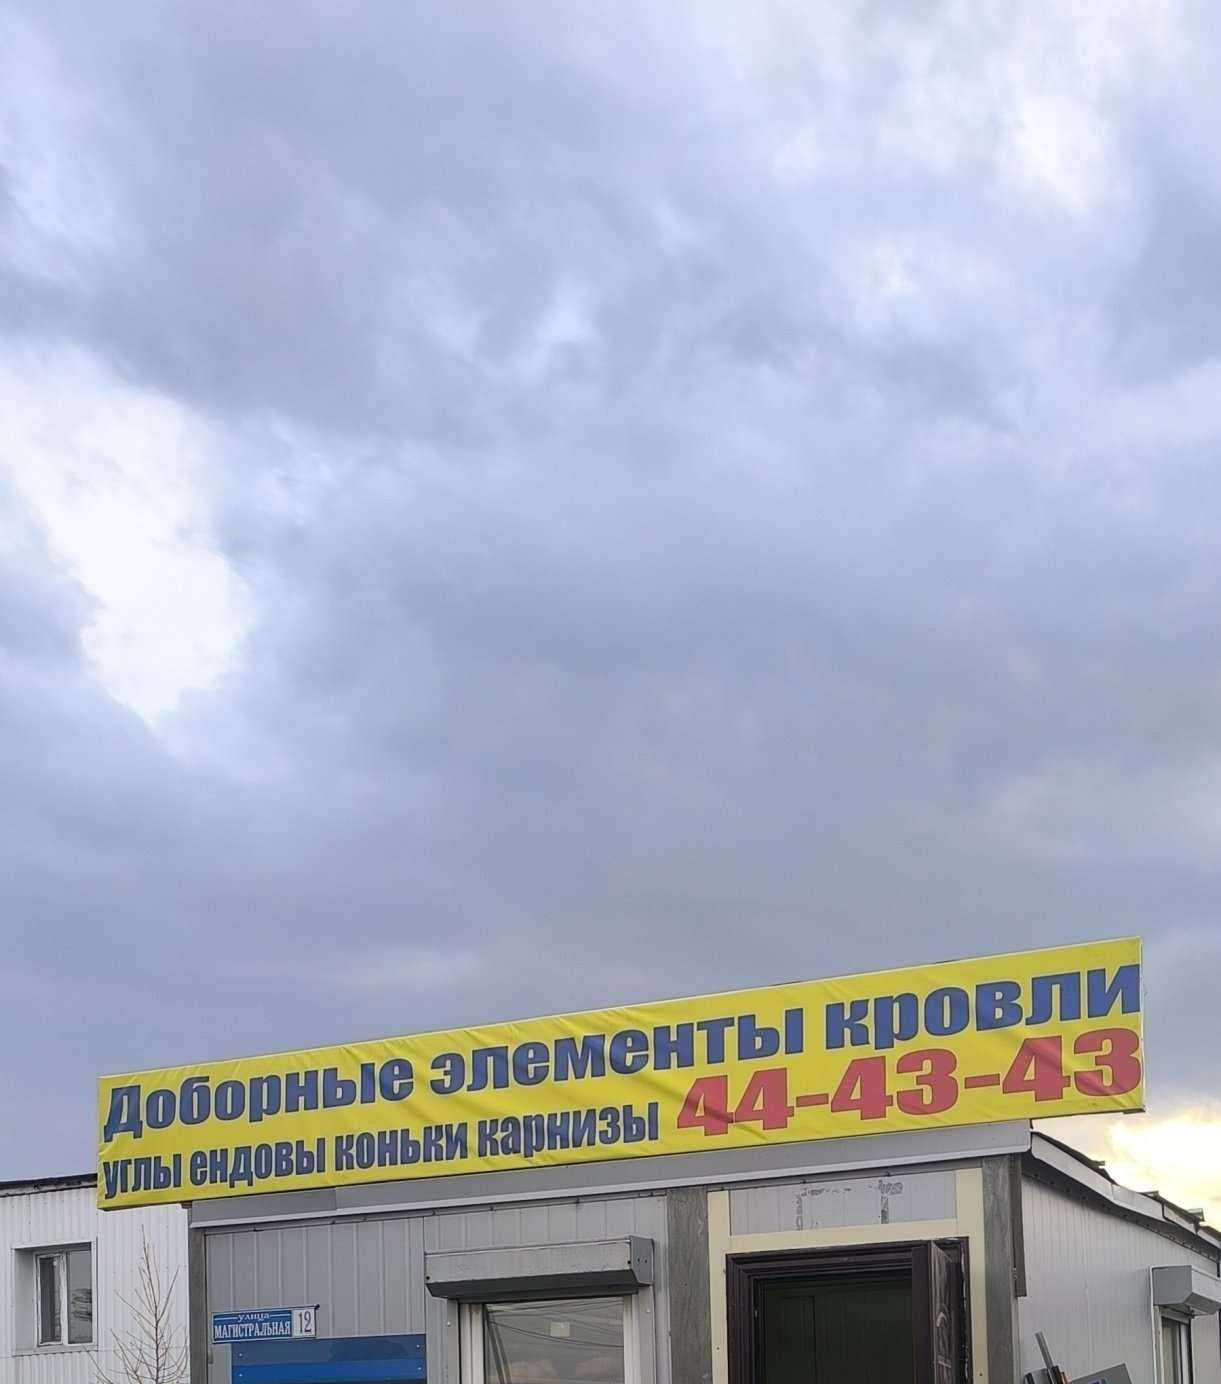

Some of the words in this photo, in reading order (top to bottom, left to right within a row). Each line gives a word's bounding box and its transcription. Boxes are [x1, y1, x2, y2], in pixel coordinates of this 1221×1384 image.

[103, 1056, 414, 1143] Доборные
[430, 1007, 804, 1096] элементы
[825, 963, 1141, 1050] кровли
[677, 1027, 1142, 1136] 44-43-43
[103, 1152, 182, 1199] углы
[190, 1137, 326, 1187] ендовы
[334, 1122, 468, 1172] коньки
[477, 1101, 659, 1158] карнизы
[214, 1322, 290, 1339] МАГИСТРАЛЬНАЯ
[238, 1313, 269, 1322] улица
[298, 1311, 312, 1334] 12
